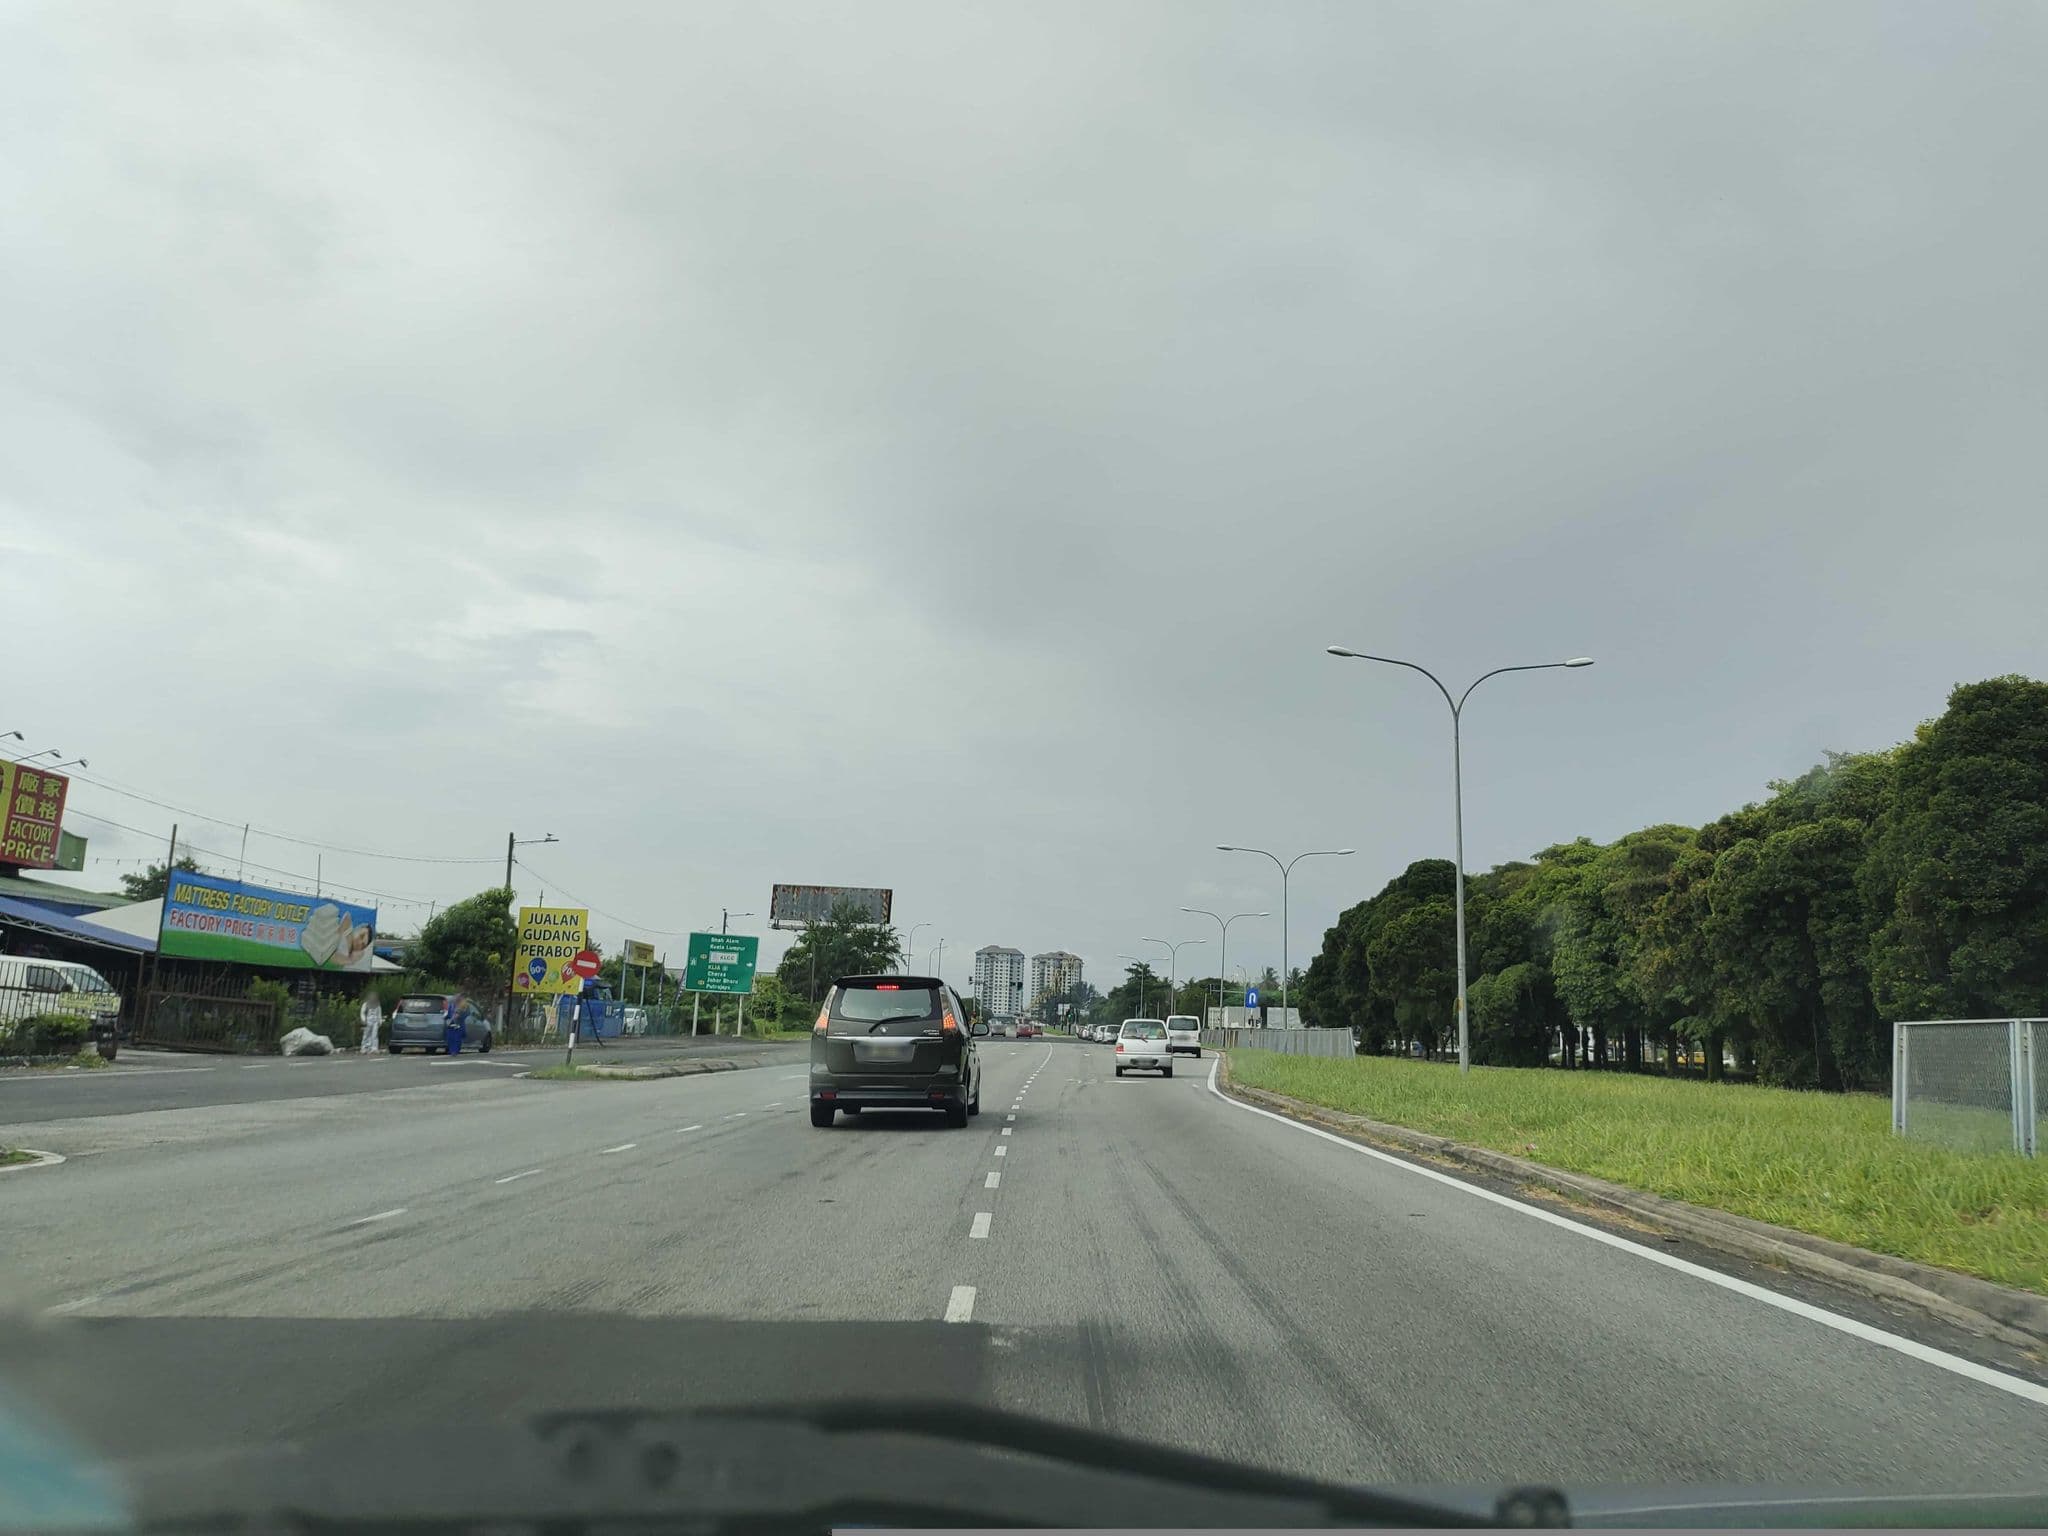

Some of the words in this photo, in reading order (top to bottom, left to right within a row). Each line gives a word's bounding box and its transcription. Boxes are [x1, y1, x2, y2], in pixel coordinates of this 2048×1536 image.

[9, 820, 55, 843] FACTORY
[174, 883, 230, 910] MATTRESS
[231, 895, 274, 918] FACTORY
[274, 903, 310, 922] OUTLET
[170, 909, 222, 932] FACTORY
[224, 919, 253, 937] PRICE
[527, 912, 579, 926] JUALAN
[523, 928, 581, 942] GUDANG
[520, 944, 580, 958] PERABOT
